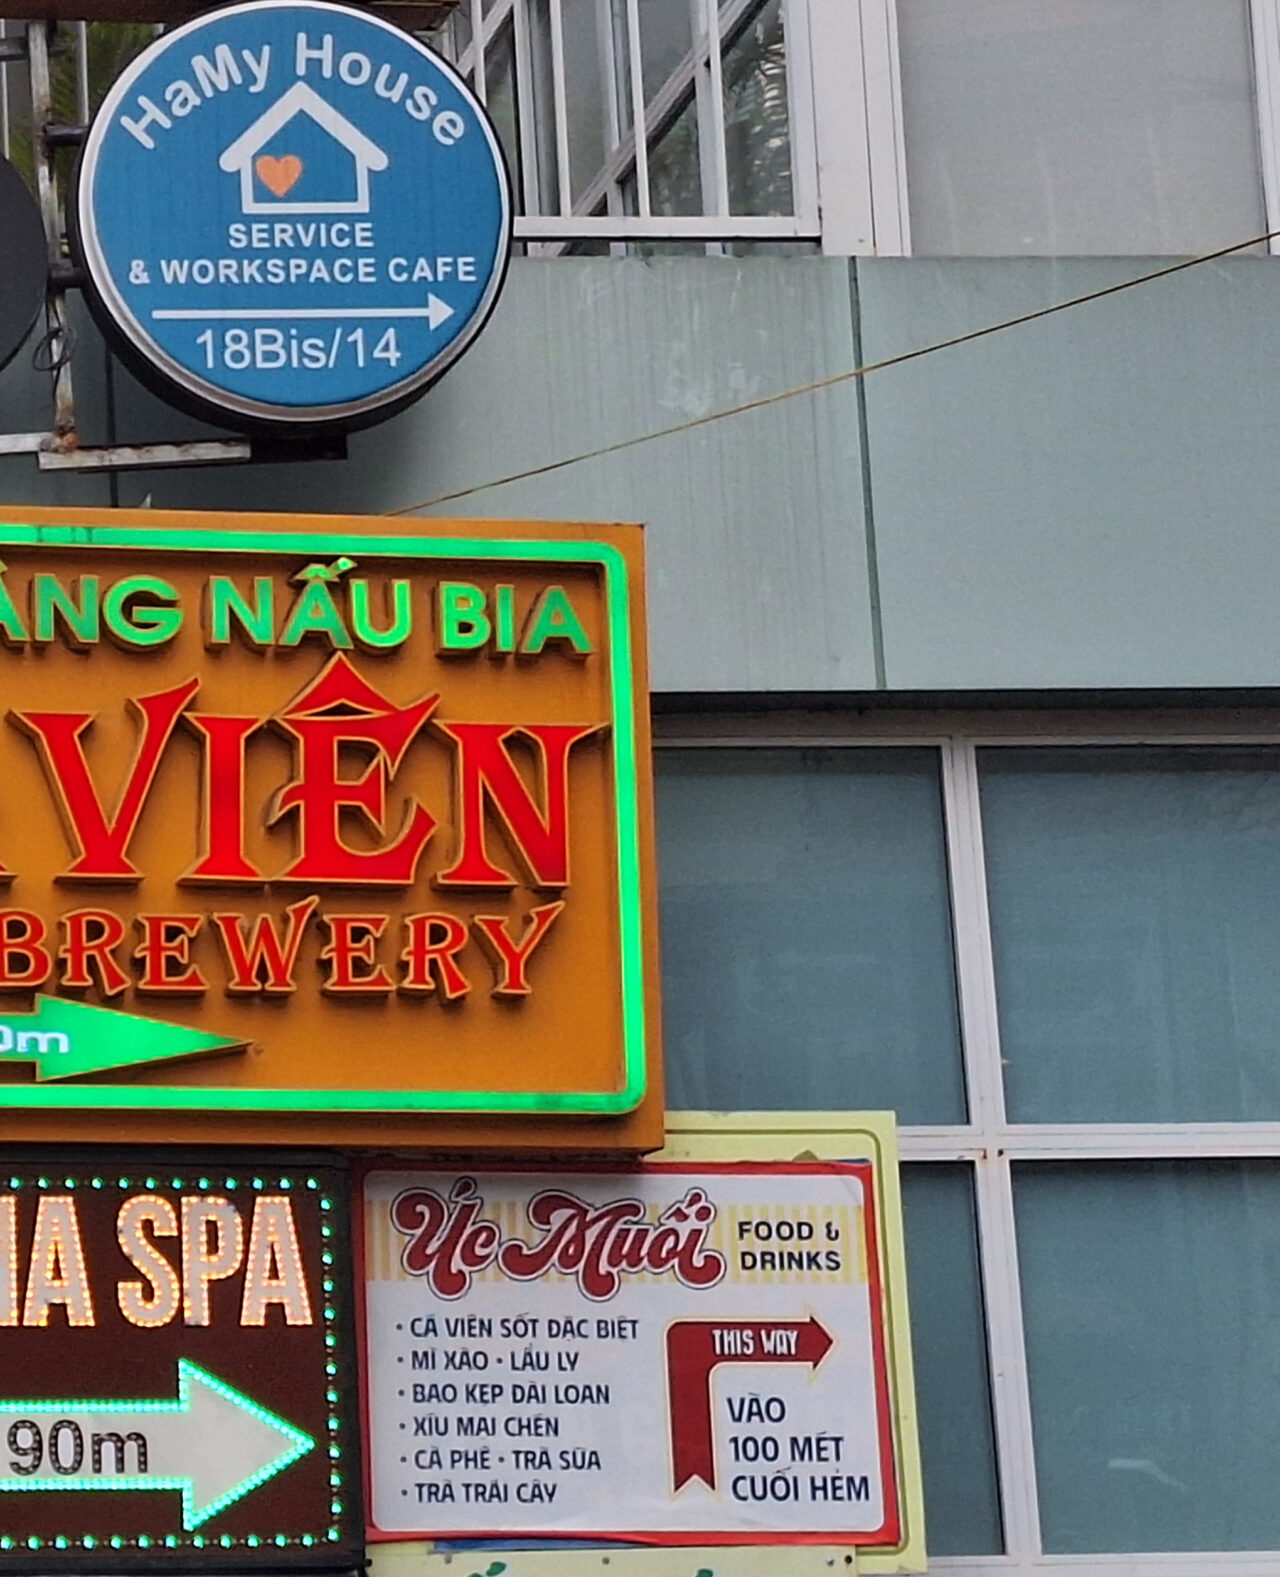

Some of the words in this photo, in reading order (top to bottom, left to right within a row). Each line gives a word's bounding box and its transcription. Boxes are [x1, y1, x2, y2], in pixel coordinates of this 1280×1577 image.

[120, 44, 270, 149] HaMy
[295, 32, 465, 146] House
[228, 221, 374, 249] SERVICE
[128, 259, 151, 285] &
[160, 258, 377, 285] WORKSPACE
[388, 256, 478, 283] CAFE
[195, 326, 402, 371] 18Bis/14
[205, 556, 412, 652] NẤU
[436, 579, 593, 658] BIA
[391, 1176, 502, 1302] Úc
[497, 1187, 727, 1302] Muối
[737, 1220, 815, 1242] FOOD
[116, 1193, 315, 1328] SPA
[740, 1249, 842, 1272] DRINKS
[444, 1313, 493, 1338] VIÊN
[712, 1329, 755, 1356] THIS
[760, 1329, 798, 1356] WAY
[554, 1384, 611, 1406] LOAN
[726, 1392, 787, 1424] VÀO
[6, 1419, 149, 1477] 90m
[729, 1436, 780, 1463] 100
[789, 1431, 845, 1463] MÉT
[731, 1465, 800, 1502] CUỐI
